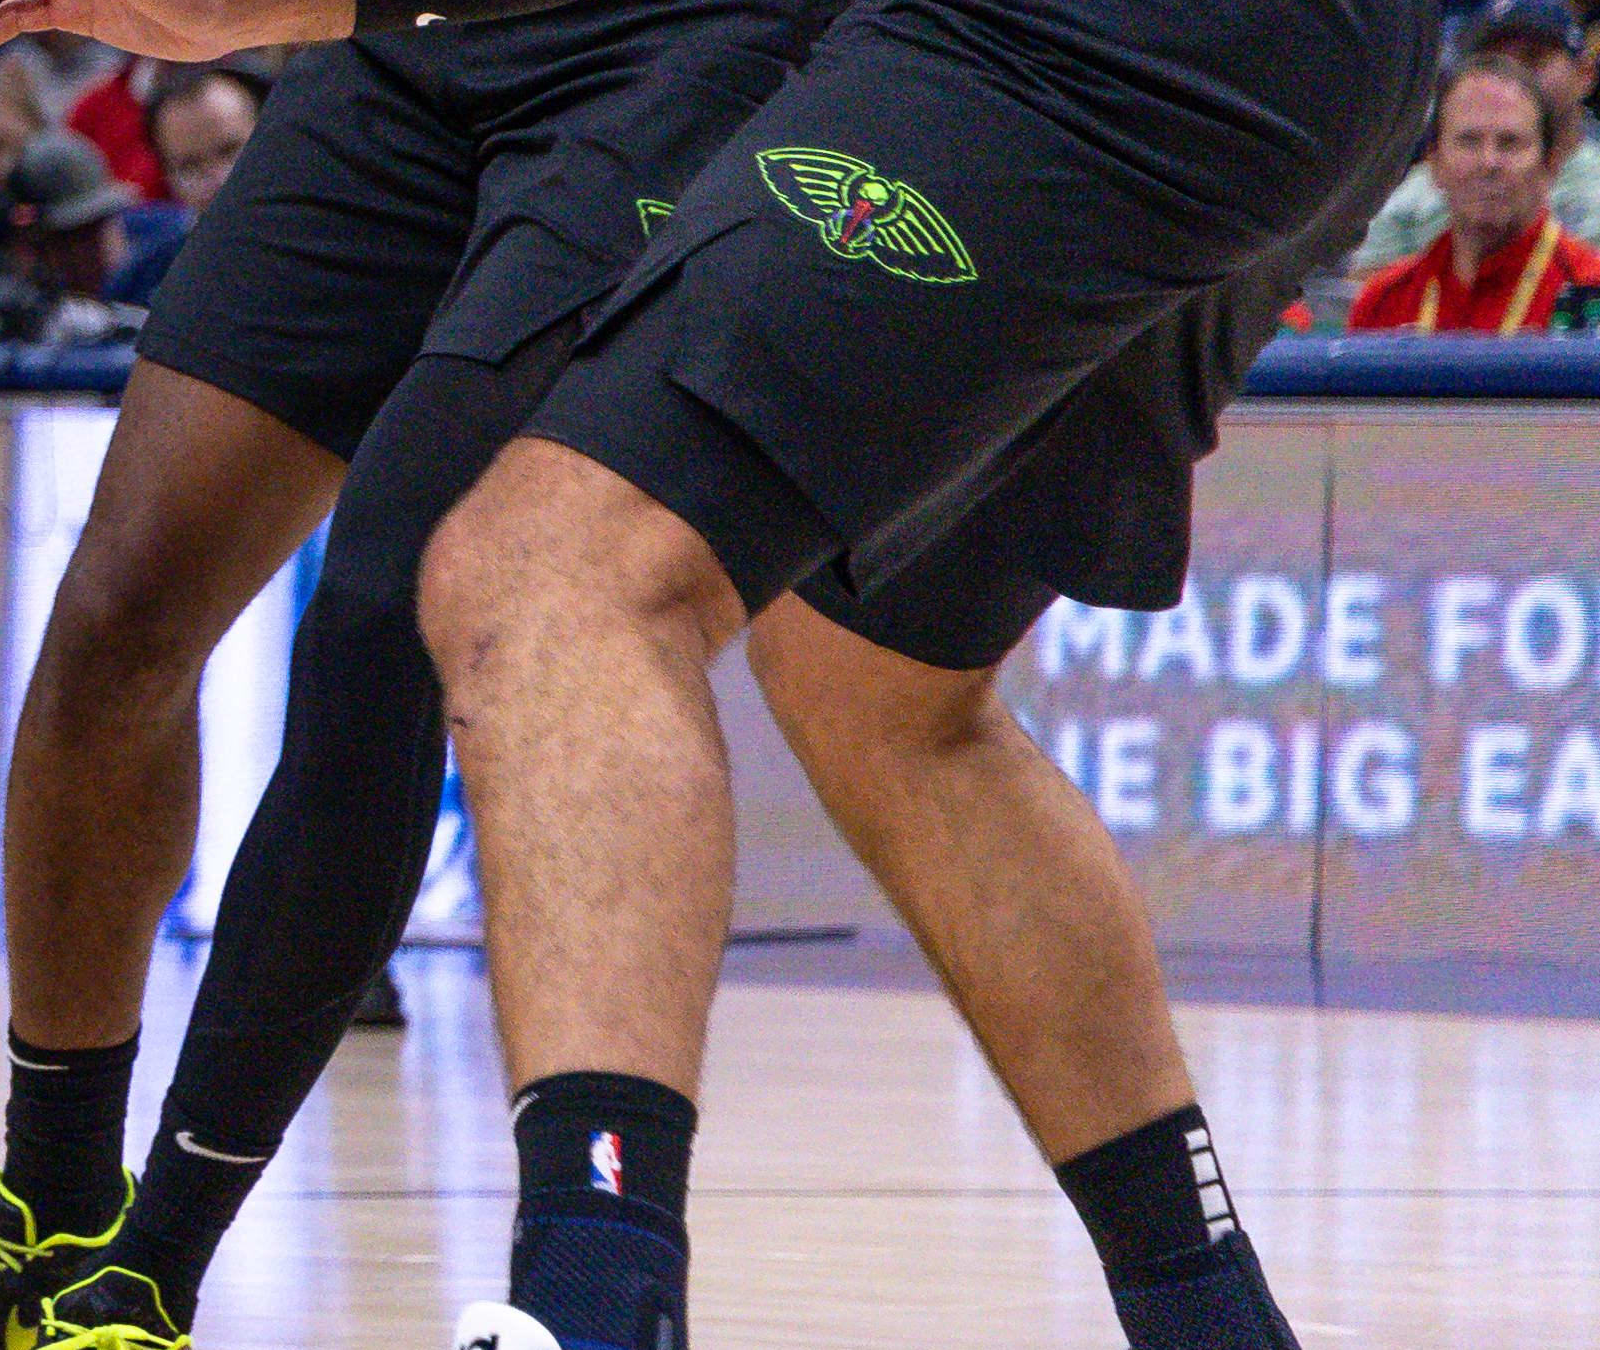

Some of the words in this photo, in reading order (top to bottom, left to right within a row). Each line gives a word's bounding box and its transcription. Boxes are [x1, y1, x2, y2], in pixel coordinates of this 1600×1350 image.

[1037, 572, 1387, 686] MADE
[1429, 574, 1600, 690] FO
[1203, 718, 1415, 836] BIG
